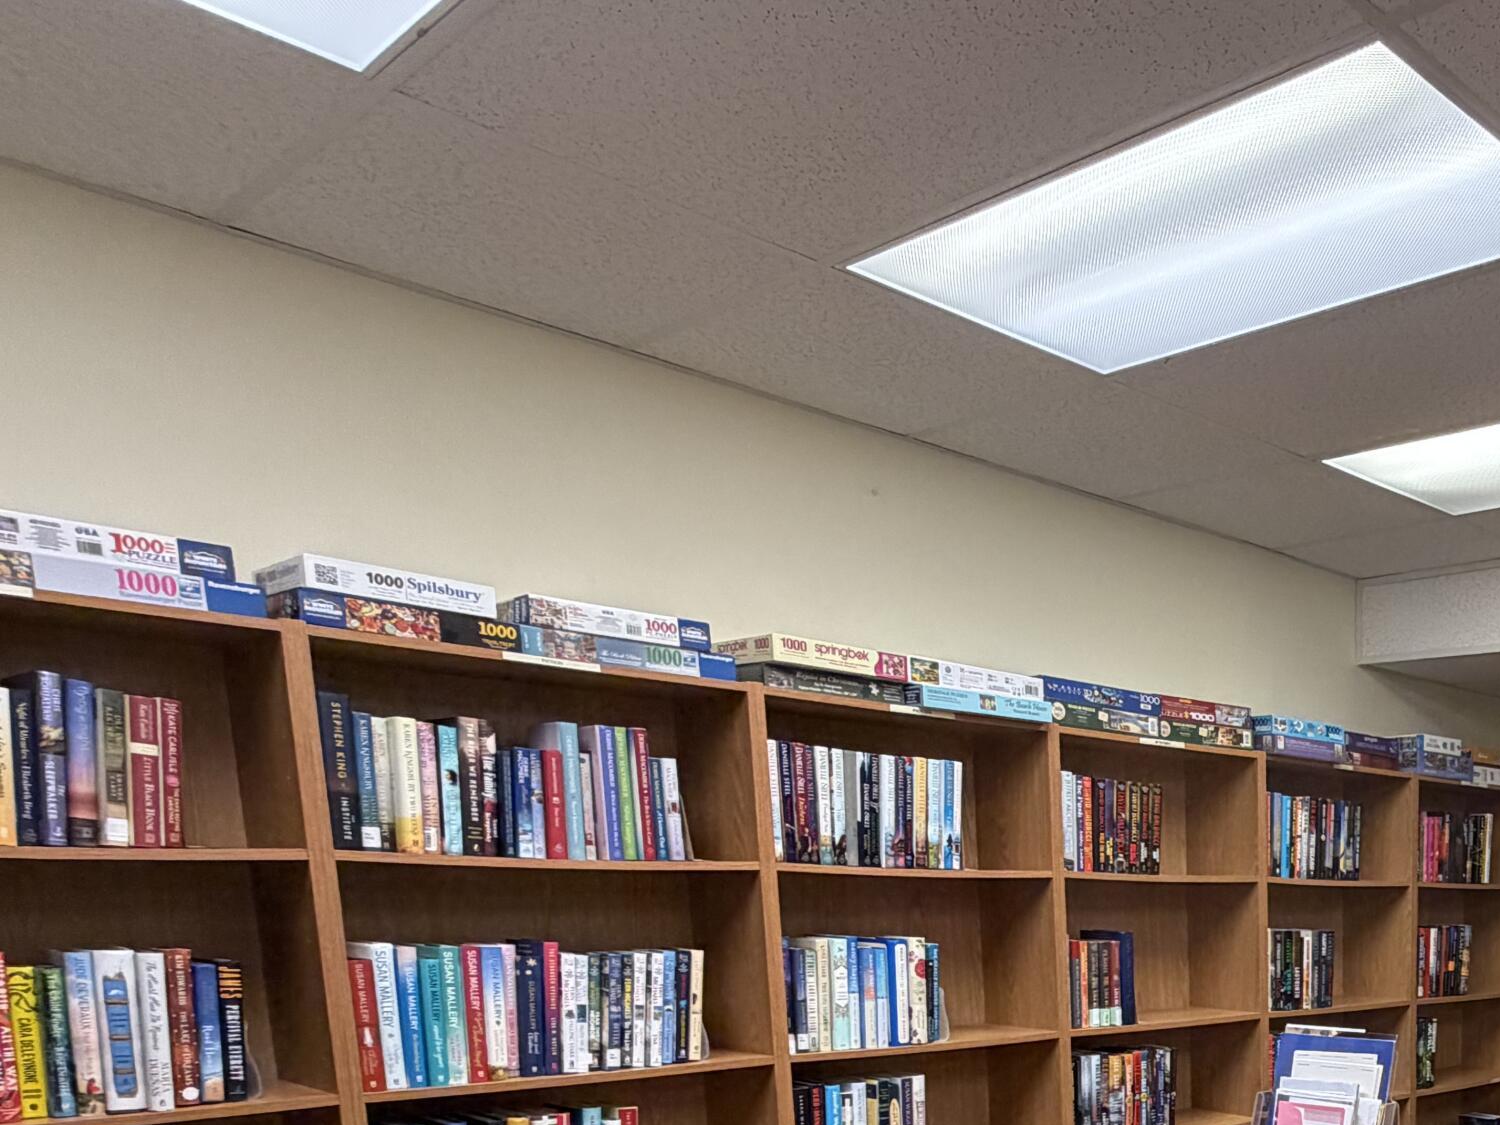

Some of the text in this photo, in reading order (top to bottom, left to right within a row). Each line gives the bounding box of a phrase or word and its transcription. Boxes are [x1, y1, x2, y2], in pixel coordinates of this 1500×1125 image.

[115, 568, 178, 597] 1000
[365, 571, 483, 603] 1000 Spilsbury
[477, 620, 517, 641] 1000
[644, 646, 682, 667] 1000
[780, 637, 870, 662] 1000 springbok
[167, 736, 179, 773] CARLISLE
[330, 702, 353, 840] STEPHEN KING INSTITUTE
[44, 760, 58, 819] SLEEPWALKER
[468, 779, 479, 821] REMEMBER
[354, 963, 370, 1023] SUSAN MALLERY
[376, 951, 393, 1028] SUSAN MALLERY
[406, 967, 418, 1030] SUSAN MALLERY
[428, 964, 440, 1022] SUSAN MALLERY
[443, 951, 459, 1028] SUSAN MALLERY
[467, 950, 481, 1010] SUSAN MALLERY
[218, 966, 244, 1081] JAMES PERCIVAL EVERETT
[20, 1039, 39, 1084] DELEVINGNE
